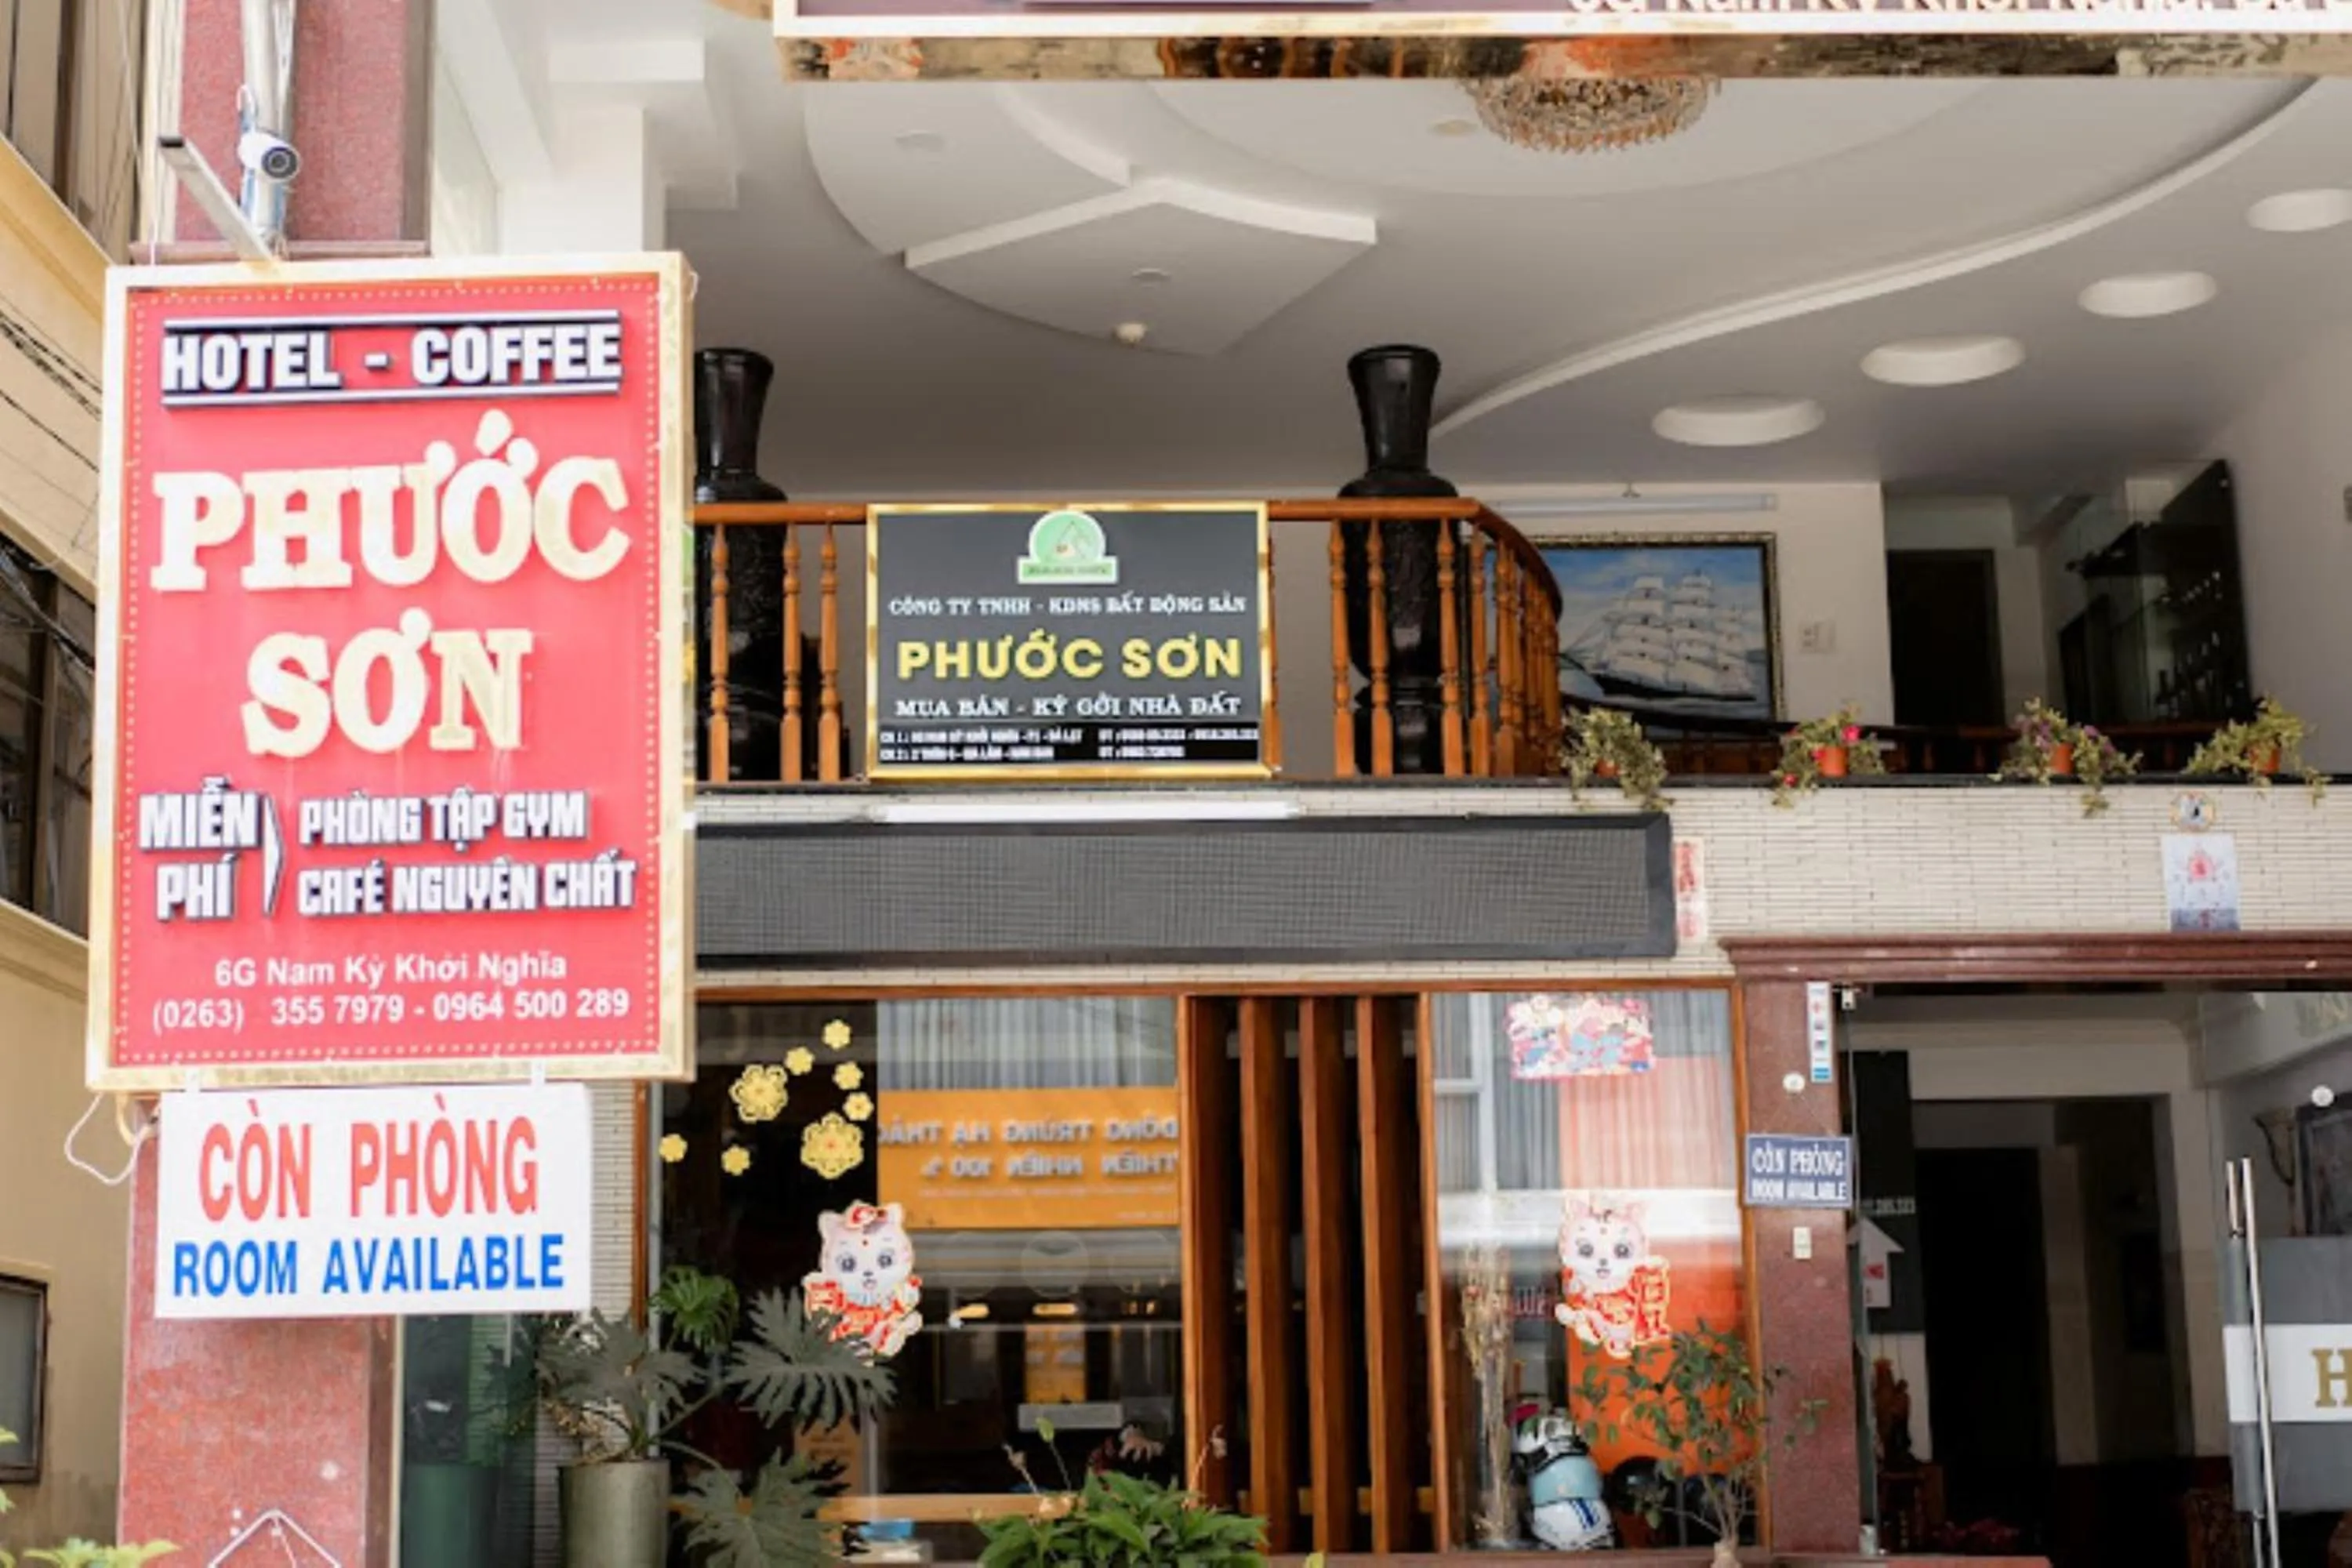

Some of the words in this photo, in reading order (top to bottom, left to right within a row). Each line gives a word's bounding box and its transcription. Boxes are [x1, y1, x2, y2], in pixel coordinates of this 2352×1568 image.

[162, 330, 341, 390] HOTEL
[364, 352, 390, 368] -
[412, 324, 622, 385] COFFEE
[151, 408, 630, 592] PHƯỚC
[946, 596, 972, 616] TY
[977, 596, 1032, 616] TNHH
[1105, 590, 1144, 614] BẤT
[240, 607, 533, 759] SƠN
[897, 628, 1104, 680] PHƯỚC
[1122, 632, 1241, 679] SƠN
[895, 698, 951, 717] MUA
[957, 694, 1010, 717] BÁN
[1189, 690, 1241, 716] ĐẤT
[139, 775, 263, 851] MIỄN
[299, 789, 423, 845] PHÒNG
[426, 786, 498, 852] TẬP
[503, 791, 588, 839] GYM
[157, 852, 238, 921] PHÍ
[297, 859, 386, 916] CAFÉ
[393, 855, 538, 912] NGUYÊN
[545, 848, 638, 908] CHẤT
[215, 957, 256, 987] 6G
[266, 956, 336, 985] Nam
[477, 950, 567, 986] Nghĩa
[152, 997, 245, 1036] (0263)
[270, 995, 326, 1025] 355
[333, 992, 405, 1024] 7979
[433, 989, 505, 1022] 0964
[514, 989, 568, 1019] 500
[575, 988, 630, 1018] 289
[198, 1098, 313, 1221] CÒN
[350, 1092, 539, 1218] PHÒNG
[173, 1239, 298, 1298] ROOM
[321, 1232, 565, 1294] AVAILABLE
